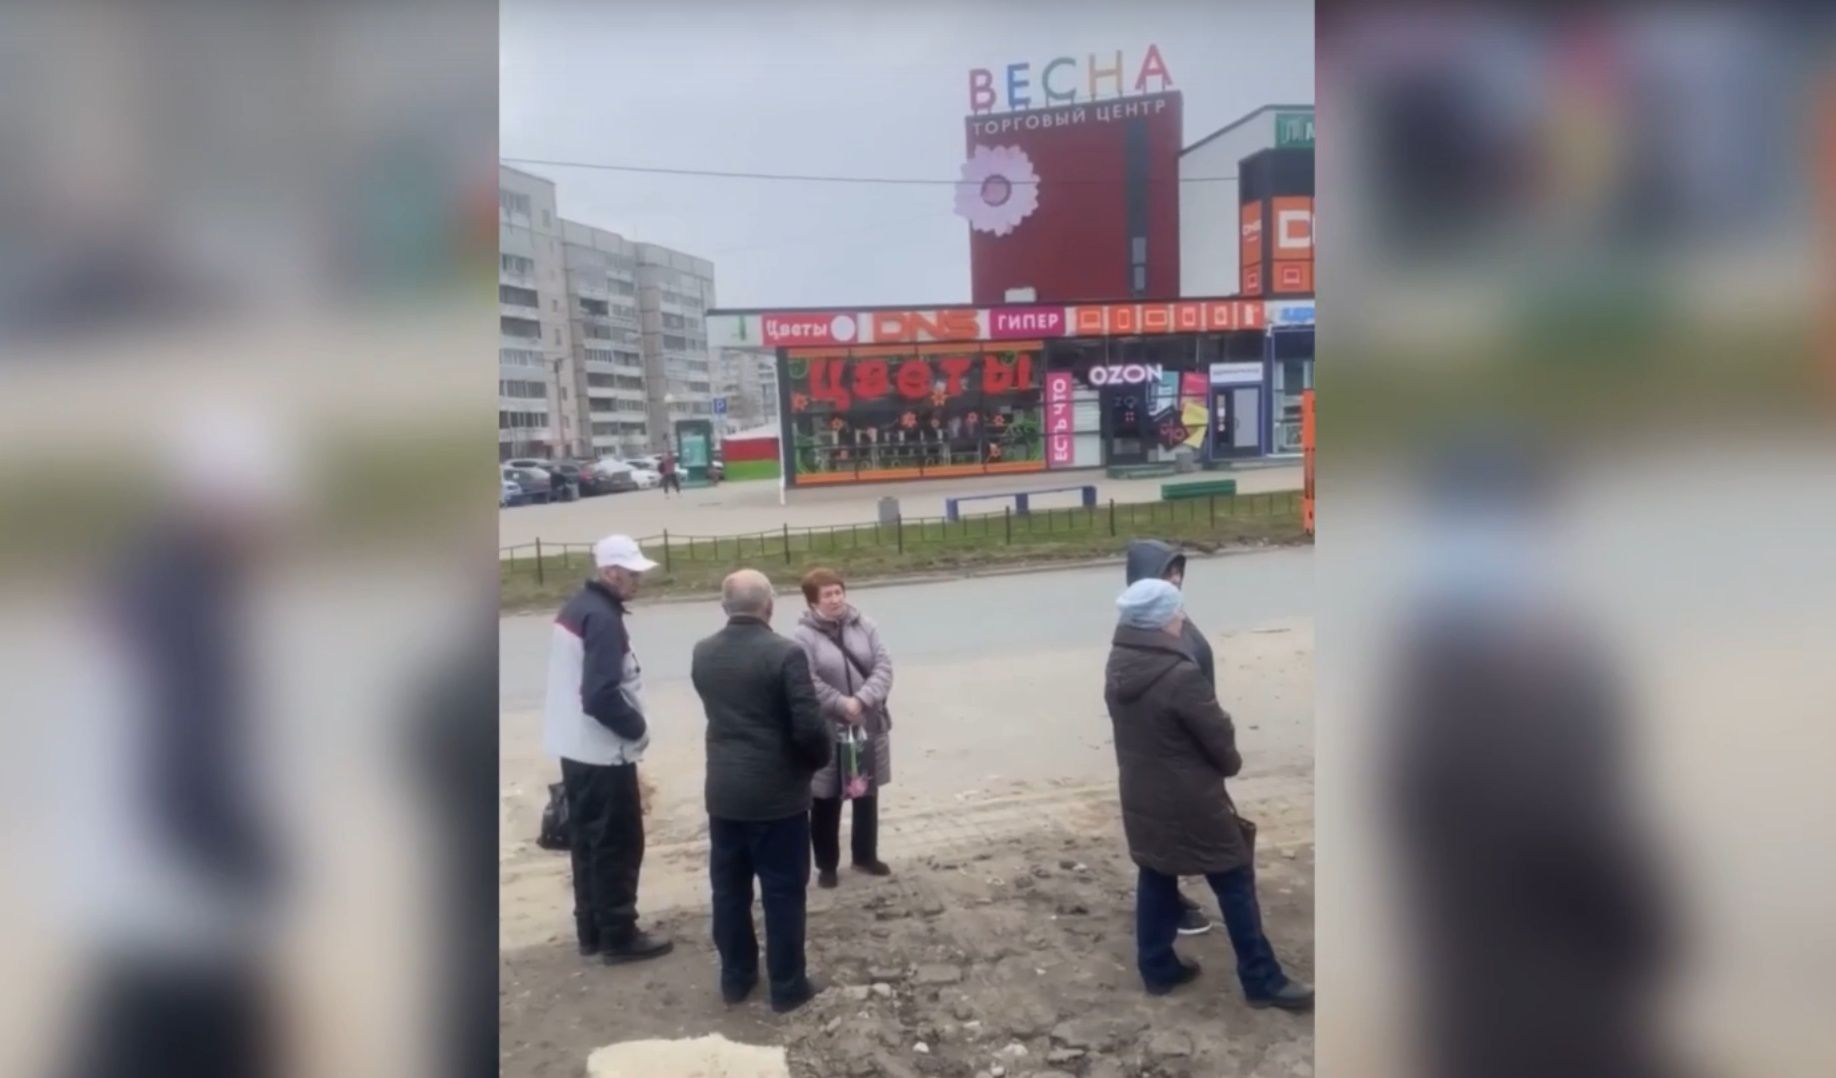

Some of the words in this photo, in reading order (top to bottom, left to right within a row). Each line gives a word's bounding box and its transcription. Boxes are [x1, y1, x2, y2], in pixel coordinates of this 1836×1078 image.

[969, 43, 1173, 112] ВЕСНА
[972, 108, 1086, 135] ТОРГОВЫЙ
[1096, 98, 1167, 121] ЦЕНТР
[766, 320, 828, 342] Цветы
[873, 311, 980, 341] DNS
[998, 312, 1060, 330] ГИПЕР
[1089, 363, 1163, 386] OZON
[1052, 378, 1067, 416] ЧТО
[1053, 418, 1068, 462] ЕСТЬ
